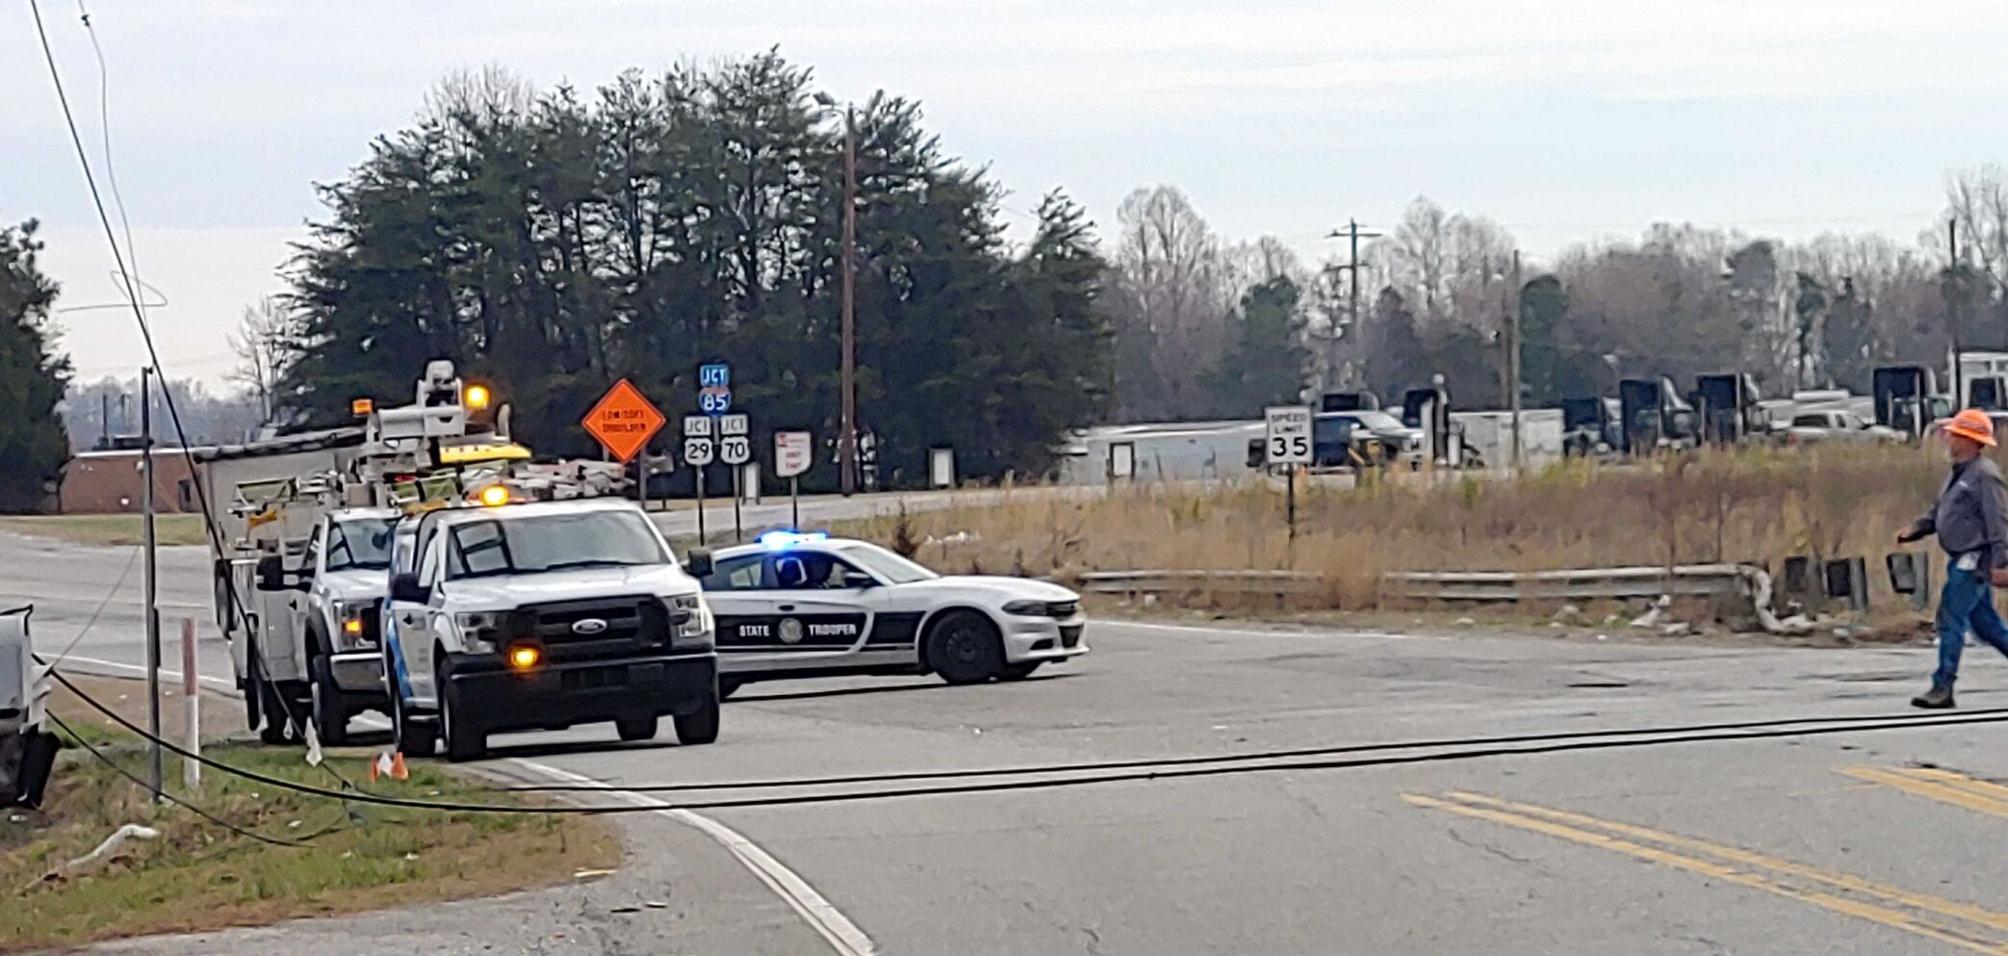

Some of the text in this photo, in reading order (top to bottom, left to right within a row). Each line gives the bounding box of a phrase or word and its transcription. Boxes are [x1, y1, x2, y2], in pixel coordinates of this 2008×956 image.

[704, 368, 726, 384] JCT
[704, 394, 726, 411] 85
[725, 417, 745, 431] JCT
[1271, 413, 1307, 423] SPEED
[688, 420, 708, 433] JCT
[1274, 424, 1303, 435] LIMIT
[688, 443, 709, 459] 29
[725, 441, 745, 459] 70
[1271, 436, 1308, 457] 35
[739, 623, 857, 637] STATE TROOPER
